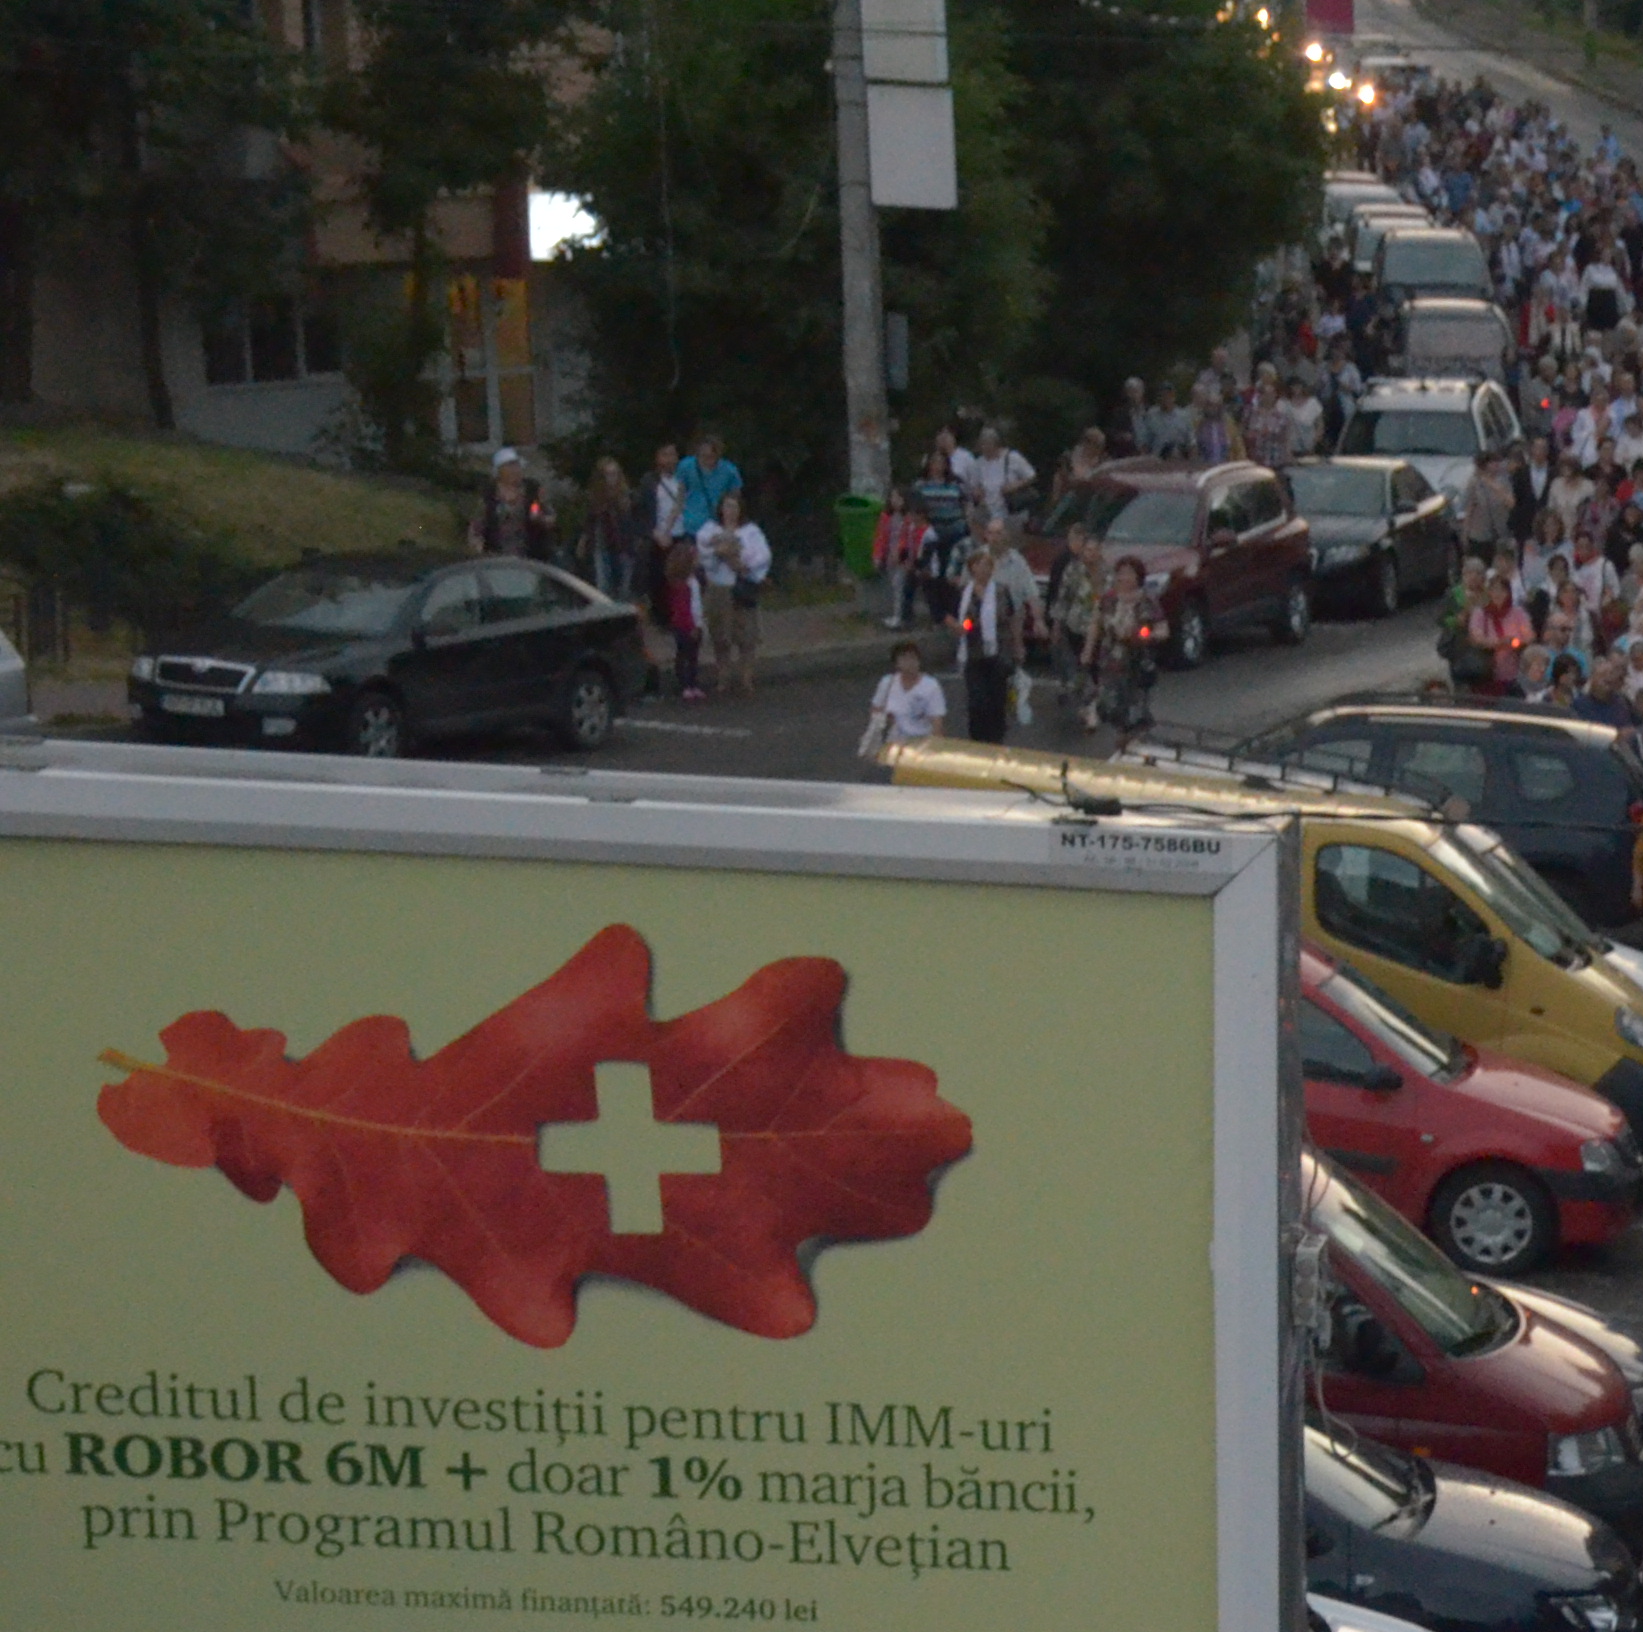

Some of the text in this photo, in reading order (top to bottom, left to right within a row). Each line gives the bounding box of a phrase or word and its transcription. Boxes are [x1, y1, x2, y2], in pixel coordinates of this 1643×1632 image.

[26, 1368, 261, 1421] Creditul
[278, 1375, 345, 1426] de
[623, 1405, 807, 1451] pentru
[825, 1401, 1053, 1454] IMM-uri
[63, 1431, 311, 1485] ROBOR
[325, 1440, 427, 1490] 6M
[445, 1451, 488, 1492] +
[507, 1447, 630, 1498] doar
[648, 1455, 744, 1502] 1%
[758, 1462, 910, 1519] marja
[923, 1462, 1096, 1523] băncii,
[81, 1494, 198, 1550] prin
[215, 1498, 515, 1558] Programul
[274, 1580, 395, 1606] Valoarea
[404, 1586, 512, 1611] maximă
[661, 1595, 776, 1621] 549.240
[785, 1599, 818, 1624] lei
